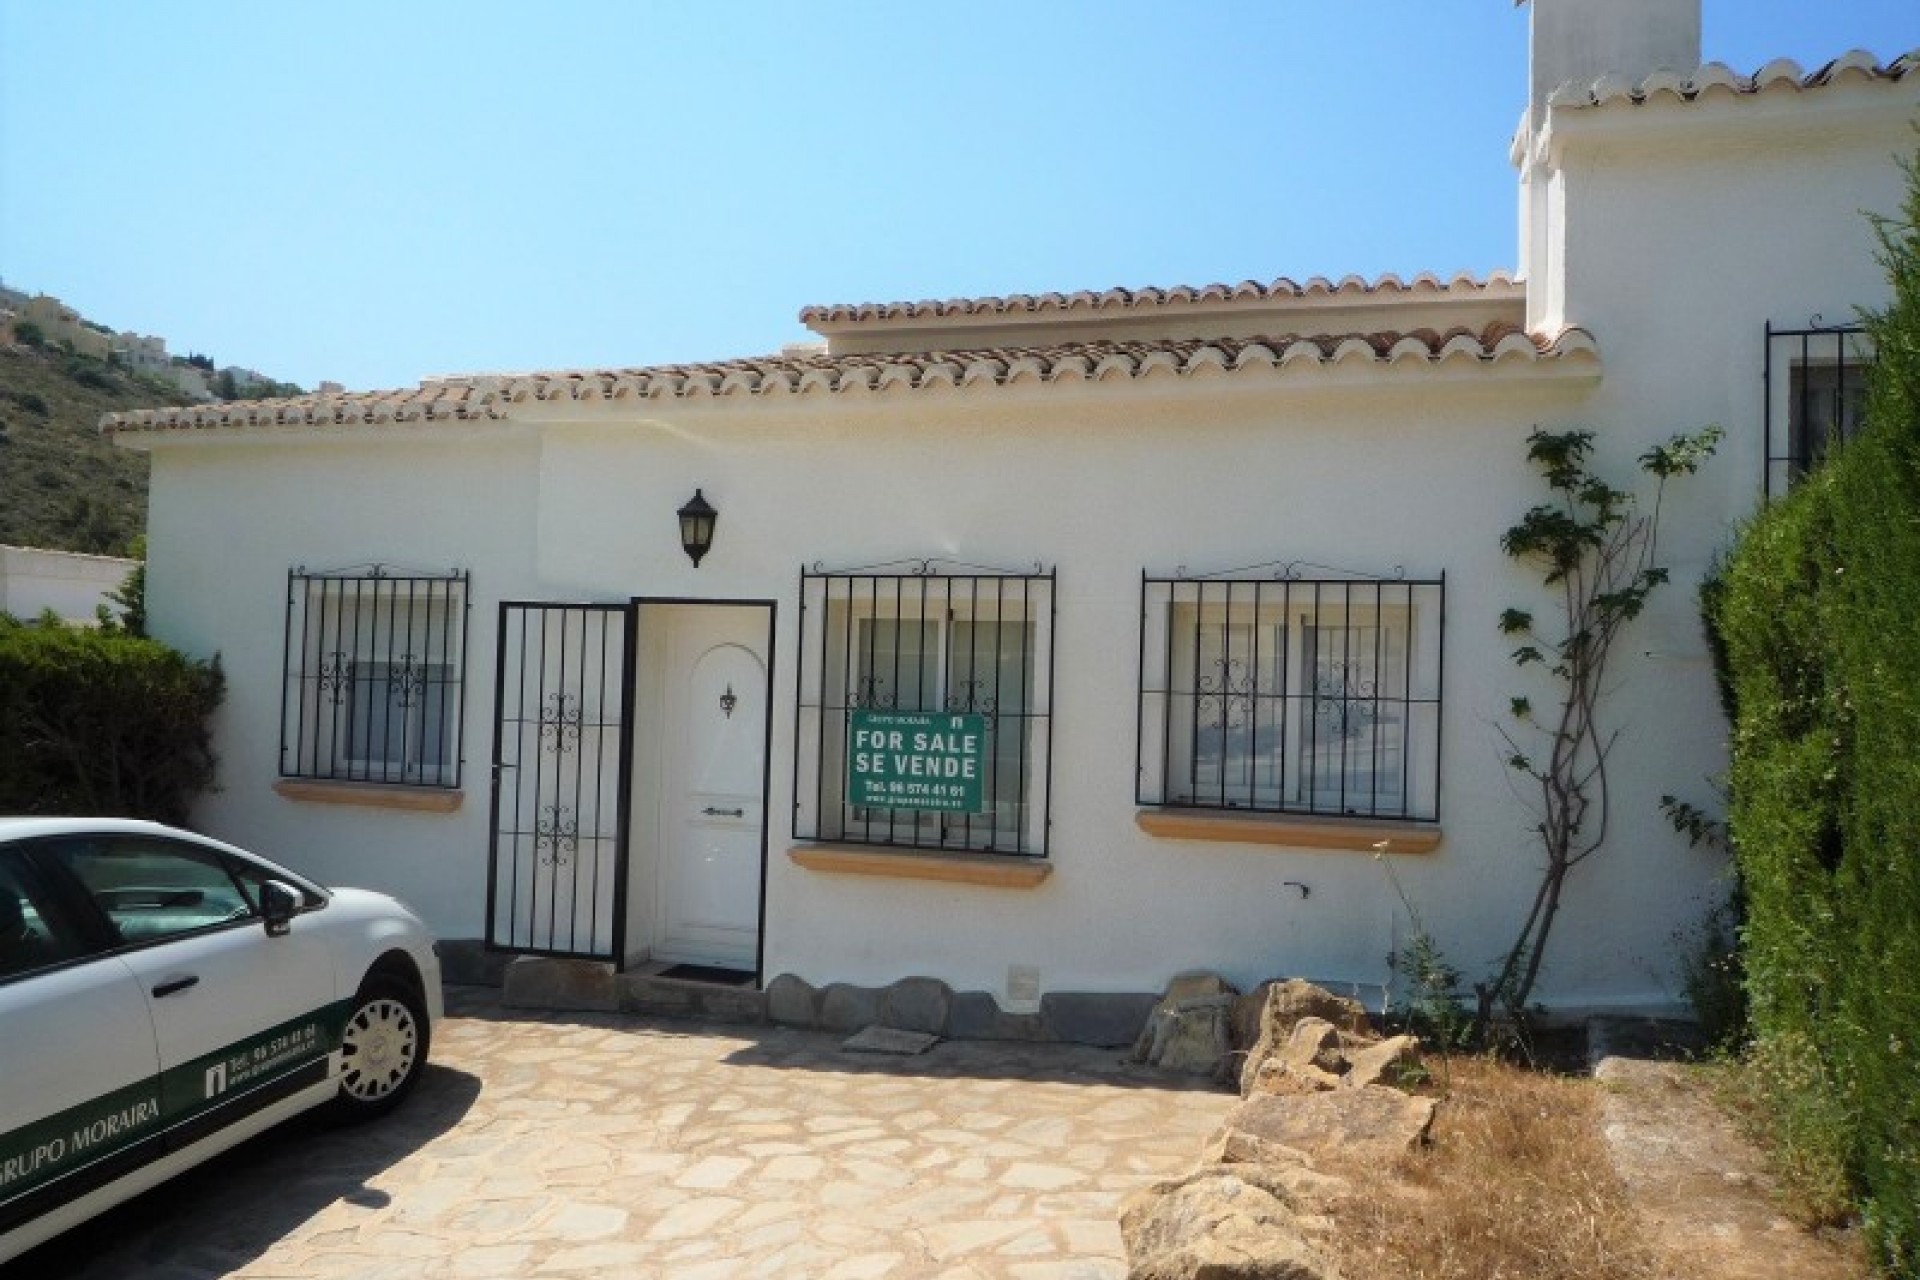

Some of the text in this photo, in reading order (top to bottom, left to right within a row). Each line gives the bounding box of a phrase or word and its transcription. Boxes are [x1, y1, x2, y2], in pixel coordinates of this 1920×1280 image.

[856, 730, 977, 754] FOR SALE
[856, 752, 976, 778] SE VENDE
[864, 780, 886, 792] Tel.
[71, 1098, 160, 1154] MORAIRA
